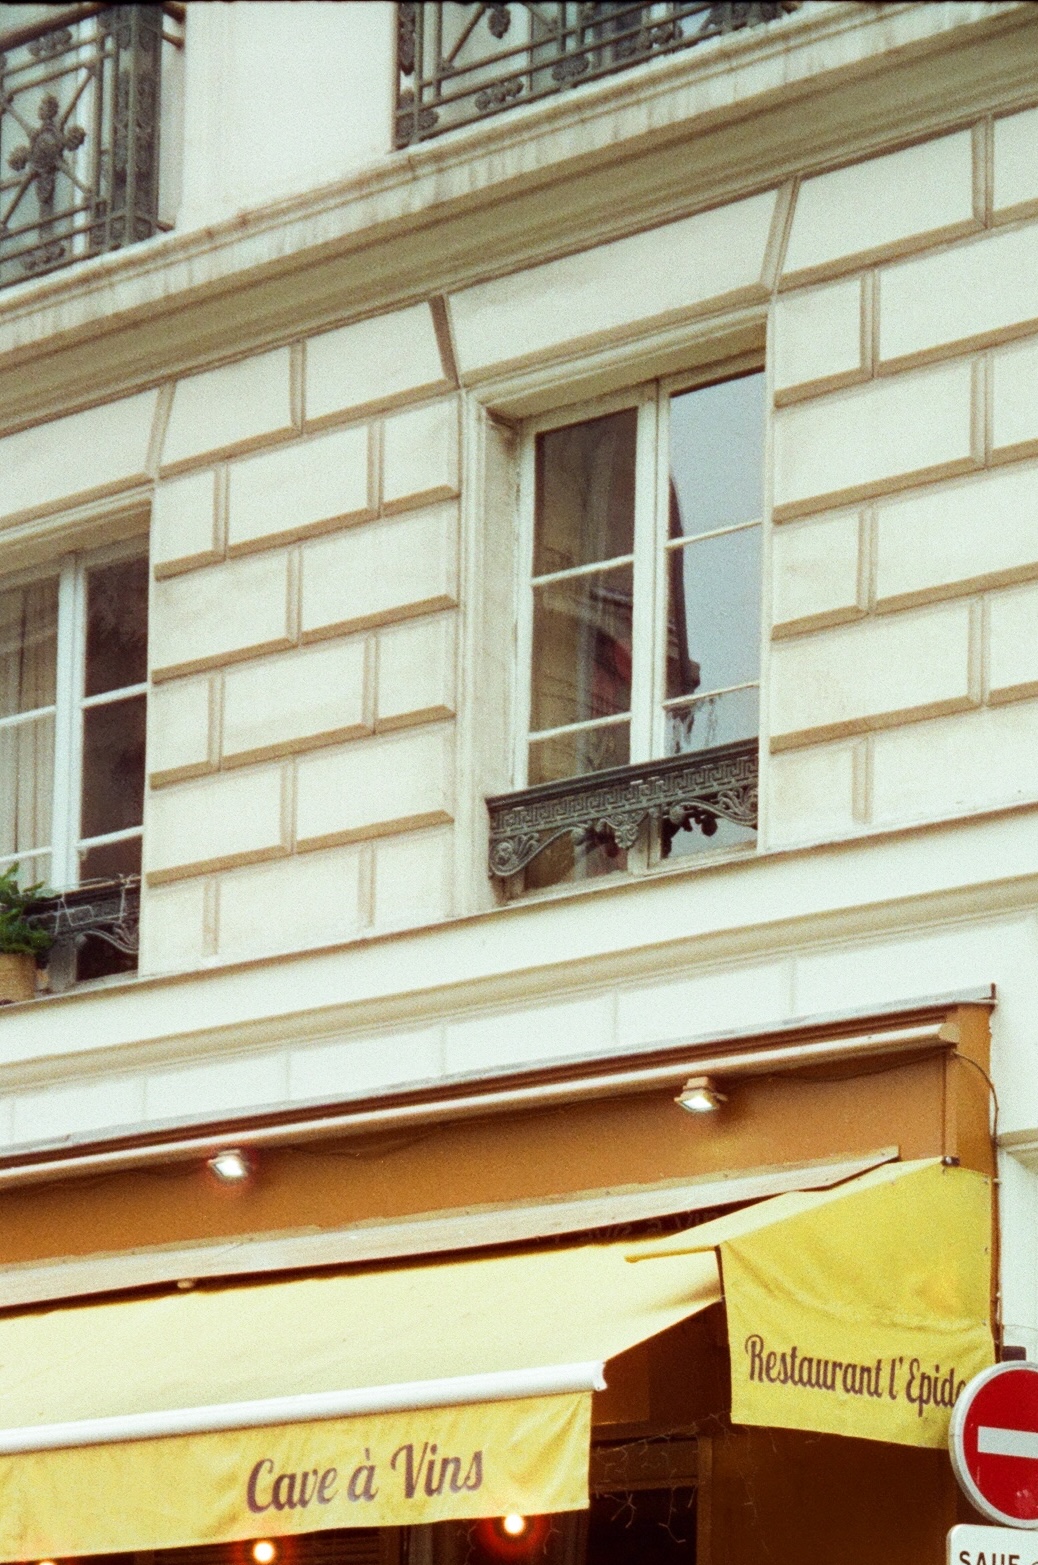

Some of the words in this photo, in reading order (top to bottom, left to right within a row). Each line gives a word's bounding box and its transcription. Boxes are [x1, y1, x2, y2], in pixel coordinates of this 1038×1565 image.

[744, 1334, 883, 1398] Restaurant
[246, 1458, 338, 1514] Cave
[347, 1448, 379, 1502] à
[390, 1441, 484, 1500] Vins
